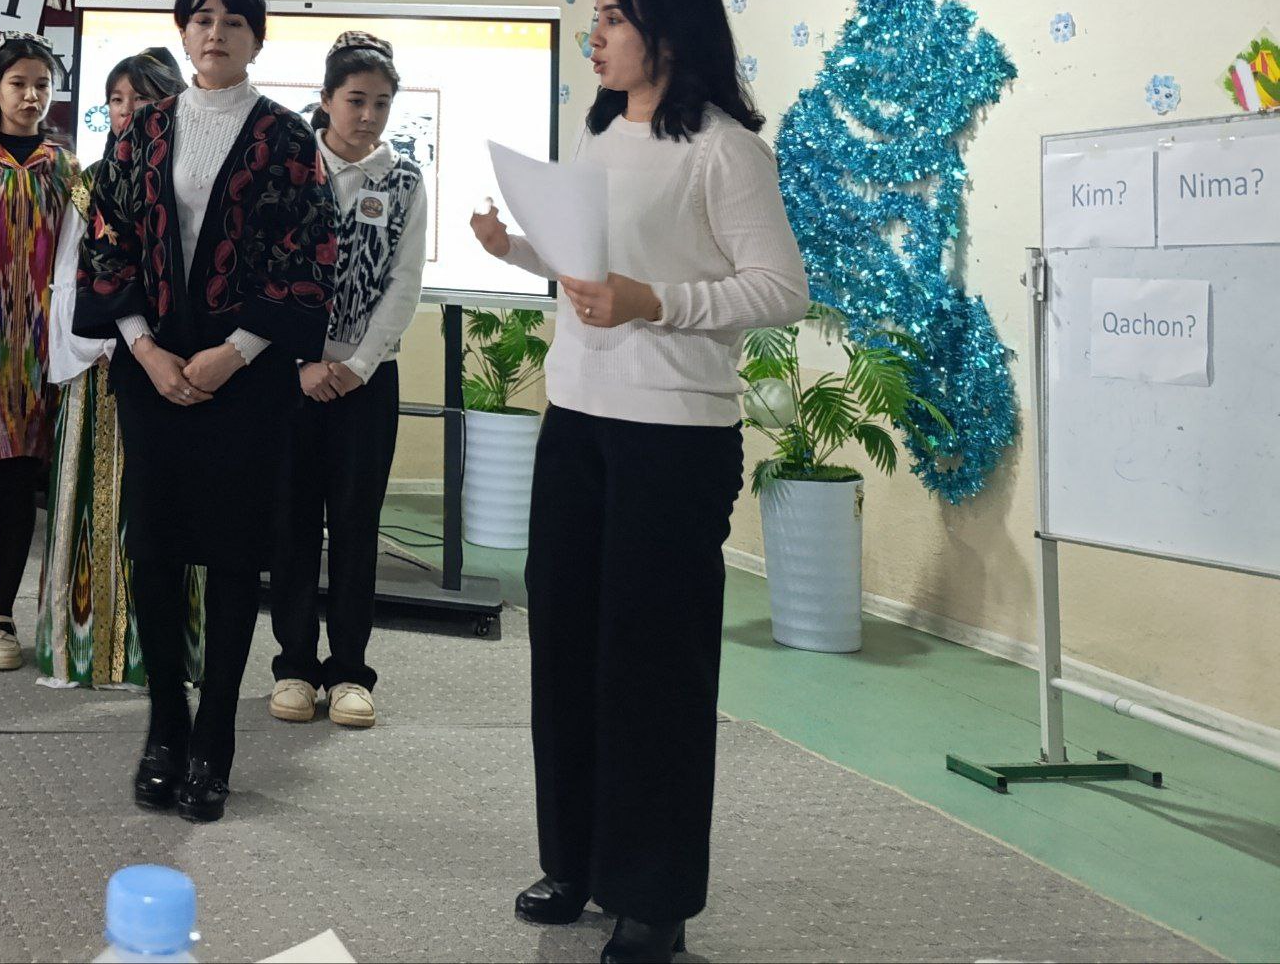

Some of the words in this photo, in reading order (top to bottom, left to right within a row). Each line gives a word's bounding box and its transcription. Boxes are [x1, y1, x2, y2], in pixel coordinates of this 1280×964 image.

[1072, 180, 1127, 208] Kim?
[1179, 168, 1264, 199] Nima?
[1102, 311, 1196, 339] Qachon?
